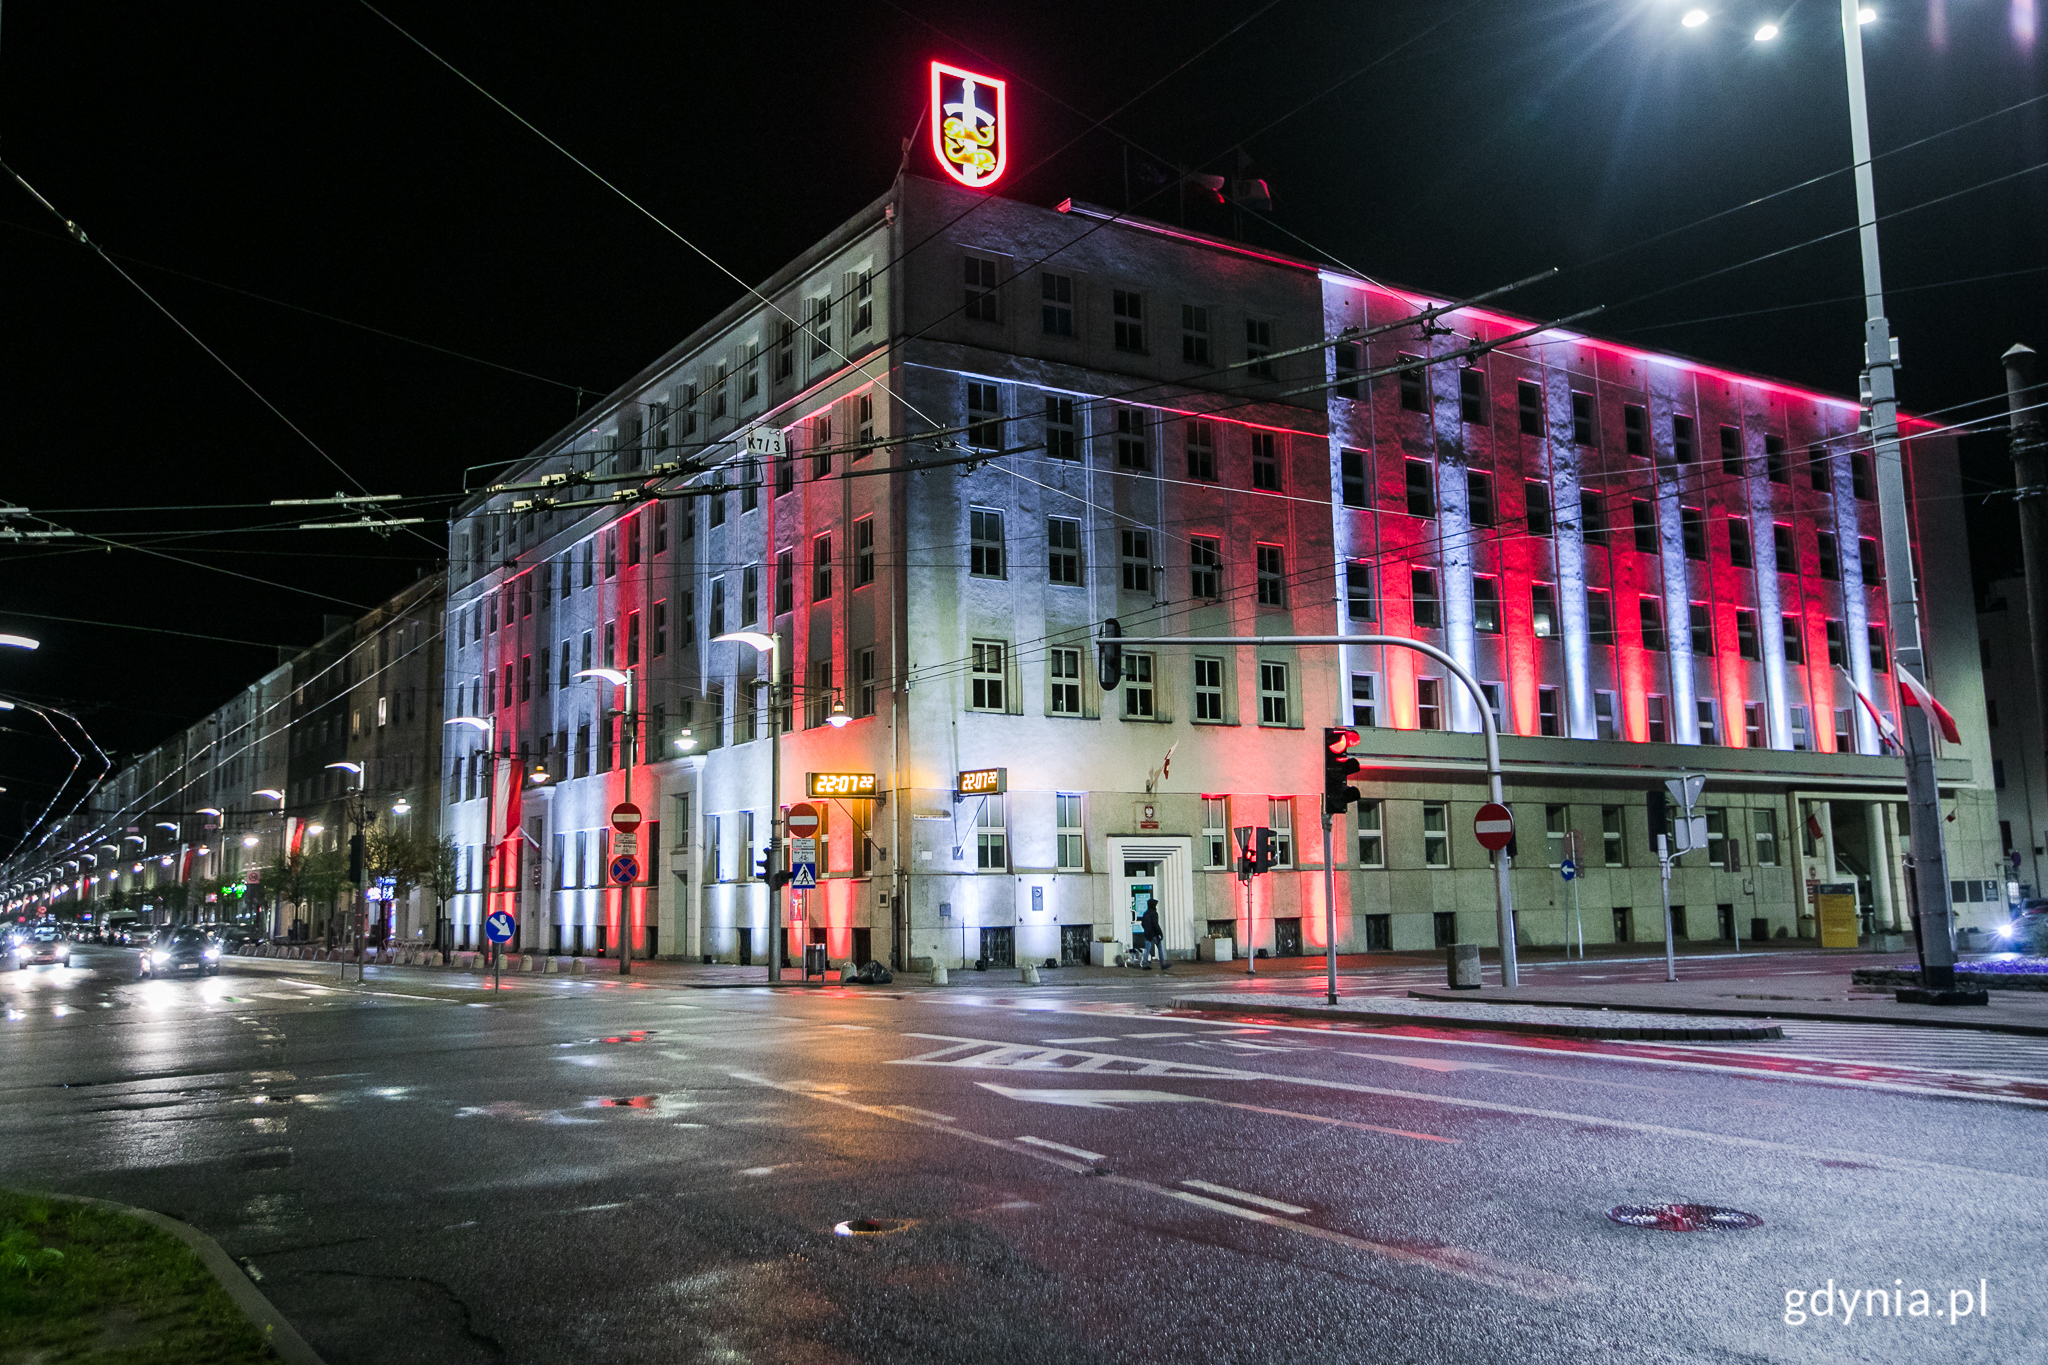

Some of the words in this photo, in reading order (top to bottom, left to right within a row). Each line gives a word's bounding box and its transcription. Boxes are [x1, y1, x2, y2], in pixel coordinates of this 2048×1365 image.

[747, 437, 780, 452] K7/3
[816, 775, 859, 792] 22:07
[859, 776, 874, 788] 22
